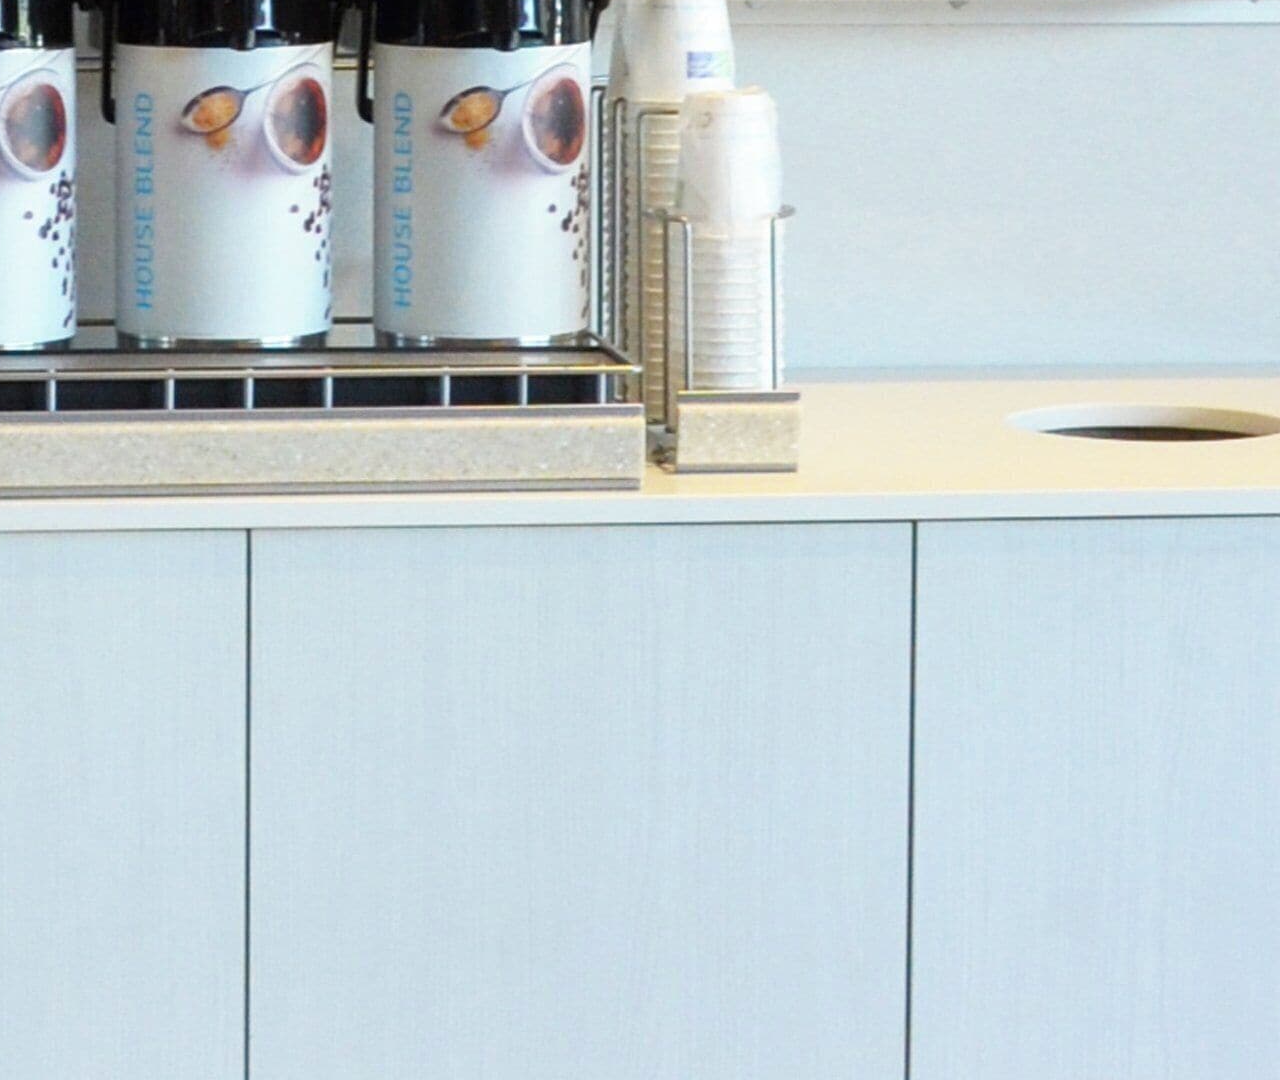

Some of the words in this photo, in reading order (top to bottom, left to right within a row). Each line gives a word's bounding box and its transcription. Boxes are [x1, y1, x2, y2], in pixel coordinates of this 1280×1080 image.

[135, 93, 153, 195] BLEND
[393, 91, 412, 194] BLEND
[135, 207, 153, 309] HOUSE
[393, 206, 412, 308] HOUSE
